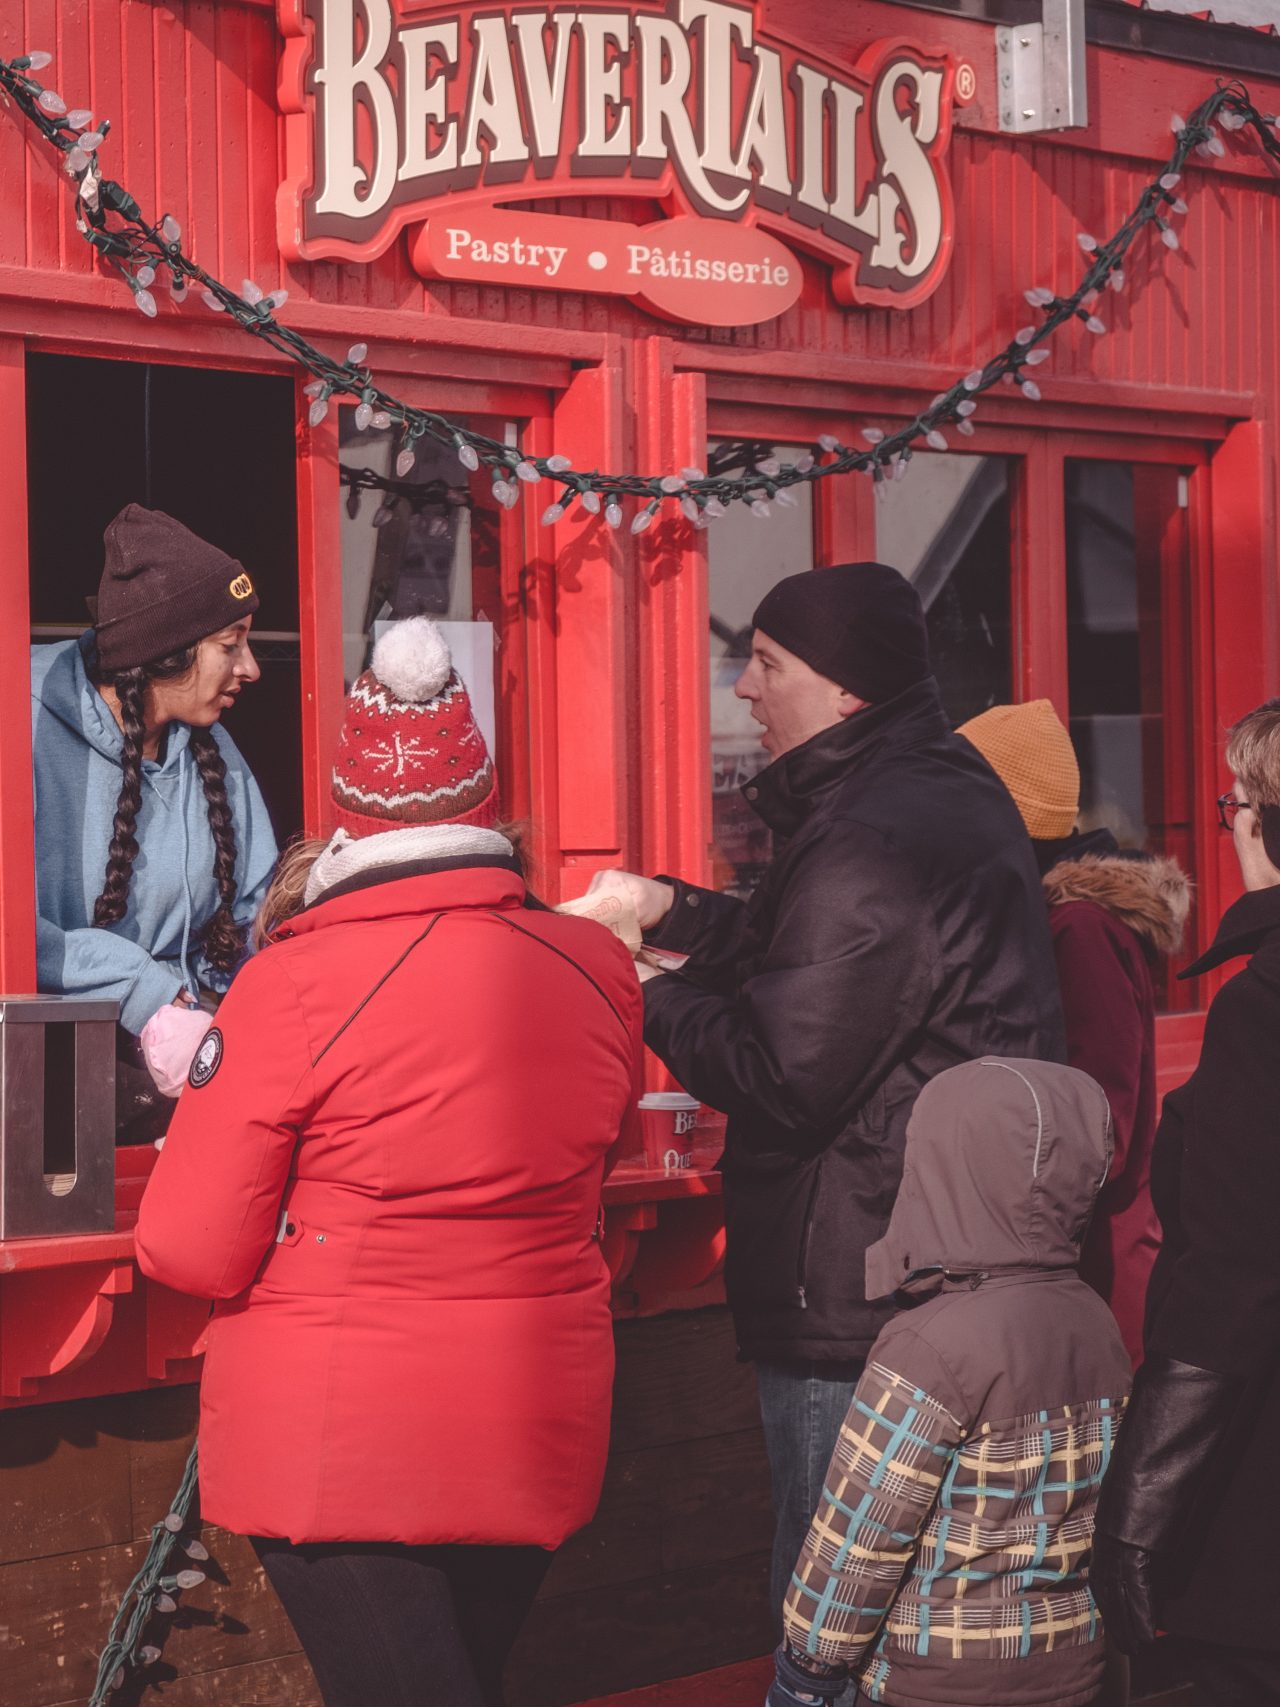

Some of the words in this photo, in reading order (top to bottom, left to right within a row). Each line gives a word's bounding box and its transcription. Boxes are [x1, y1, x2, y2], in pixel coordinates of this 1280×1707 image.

[446, 230, 568, 276] Pastry
[627, 244, 789, 288] Pâtisserie
[674, 1111, 697, 1134] BE
